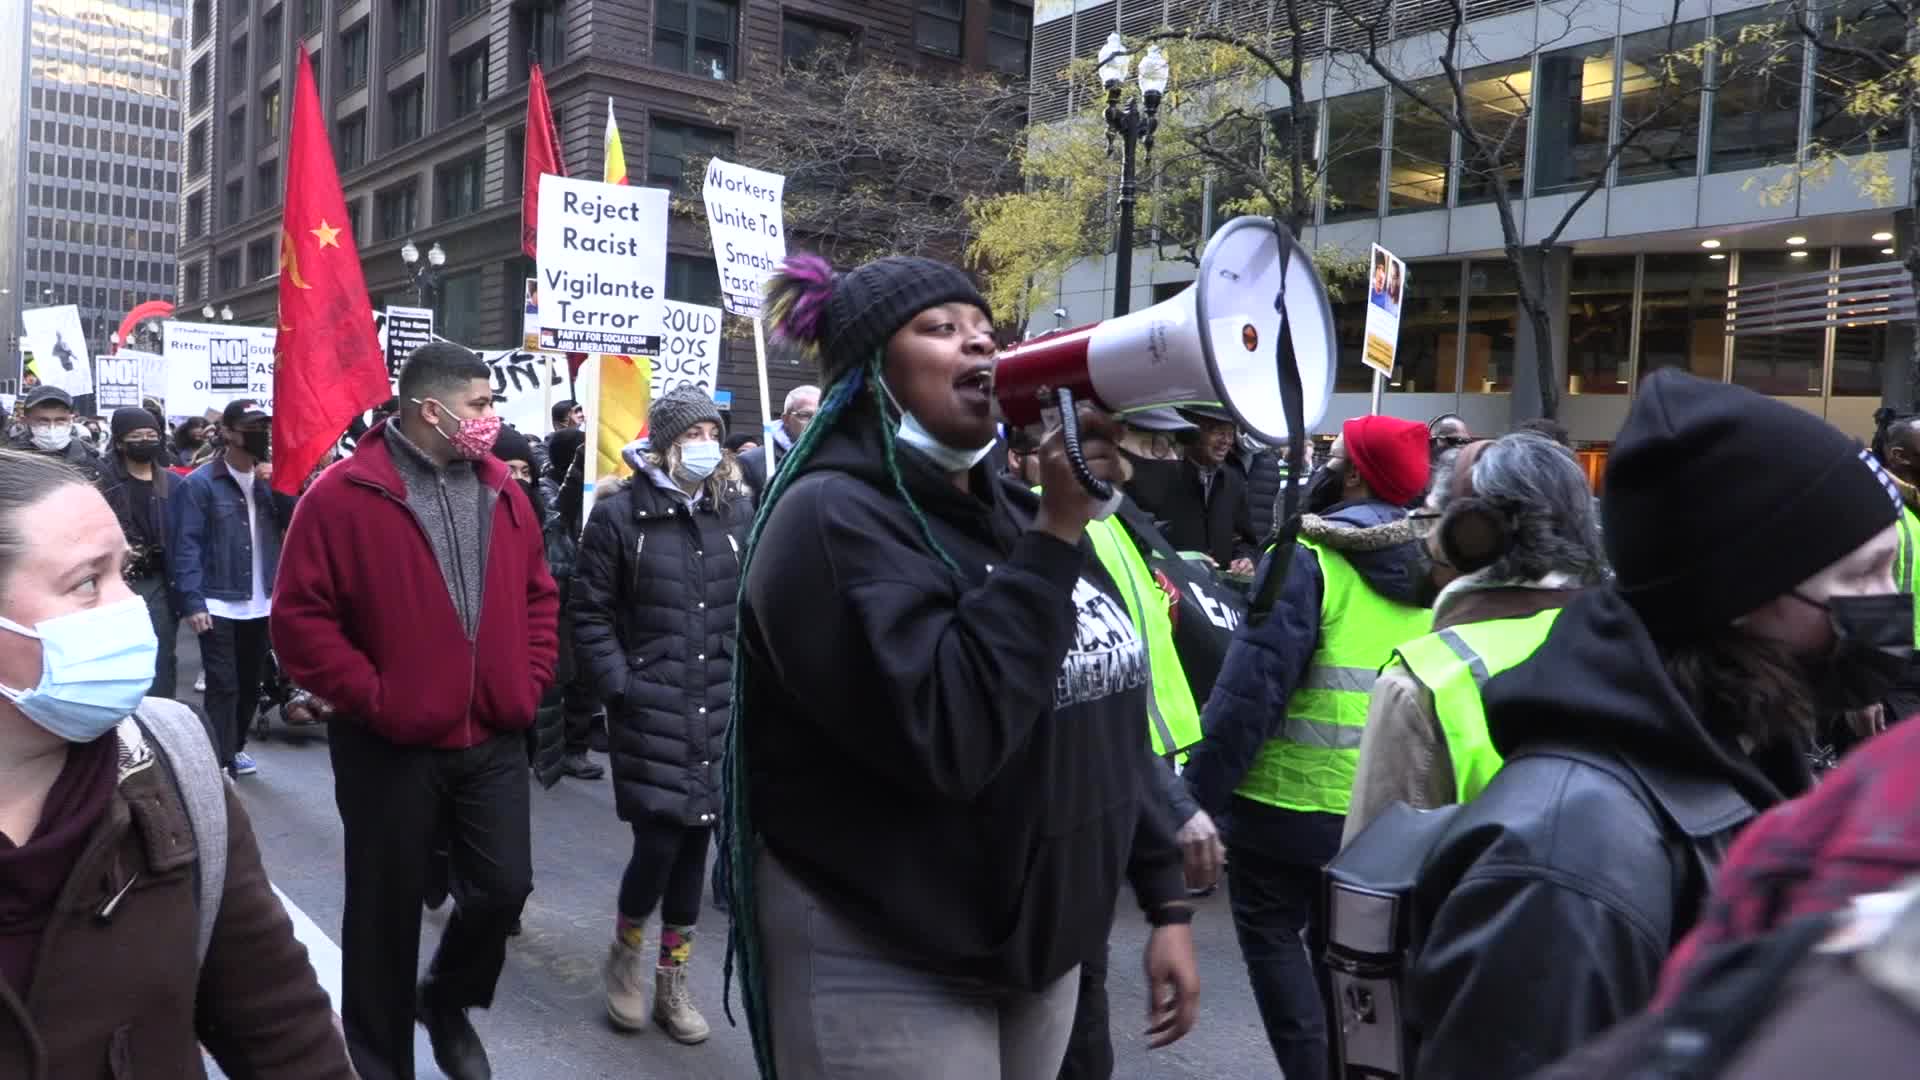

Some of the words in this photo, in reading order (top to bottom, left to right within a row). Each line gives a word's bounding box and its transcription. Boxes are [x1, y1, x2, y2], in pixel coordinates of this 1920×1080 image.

[710, 163, 776, 203] Workers
[564, 191, 640, 224] Reject
[711, 201, 756, 231] Unite
[760, 213, 777, 237] To
[563, 227, 638, 257] Racist
[726, 242, 775, 272] Smash
[545, 268, 655, 300] Vigilante
[557, 300, 640, 329] Terror
[663, 306, 716, 334] ROUD
[210, 339, 247, 364] NO!
[558, 329, 585, 341] PARTY
[603, 334, 647, 345] SOCIALISM
[100, 359, 138, 384] NO!
